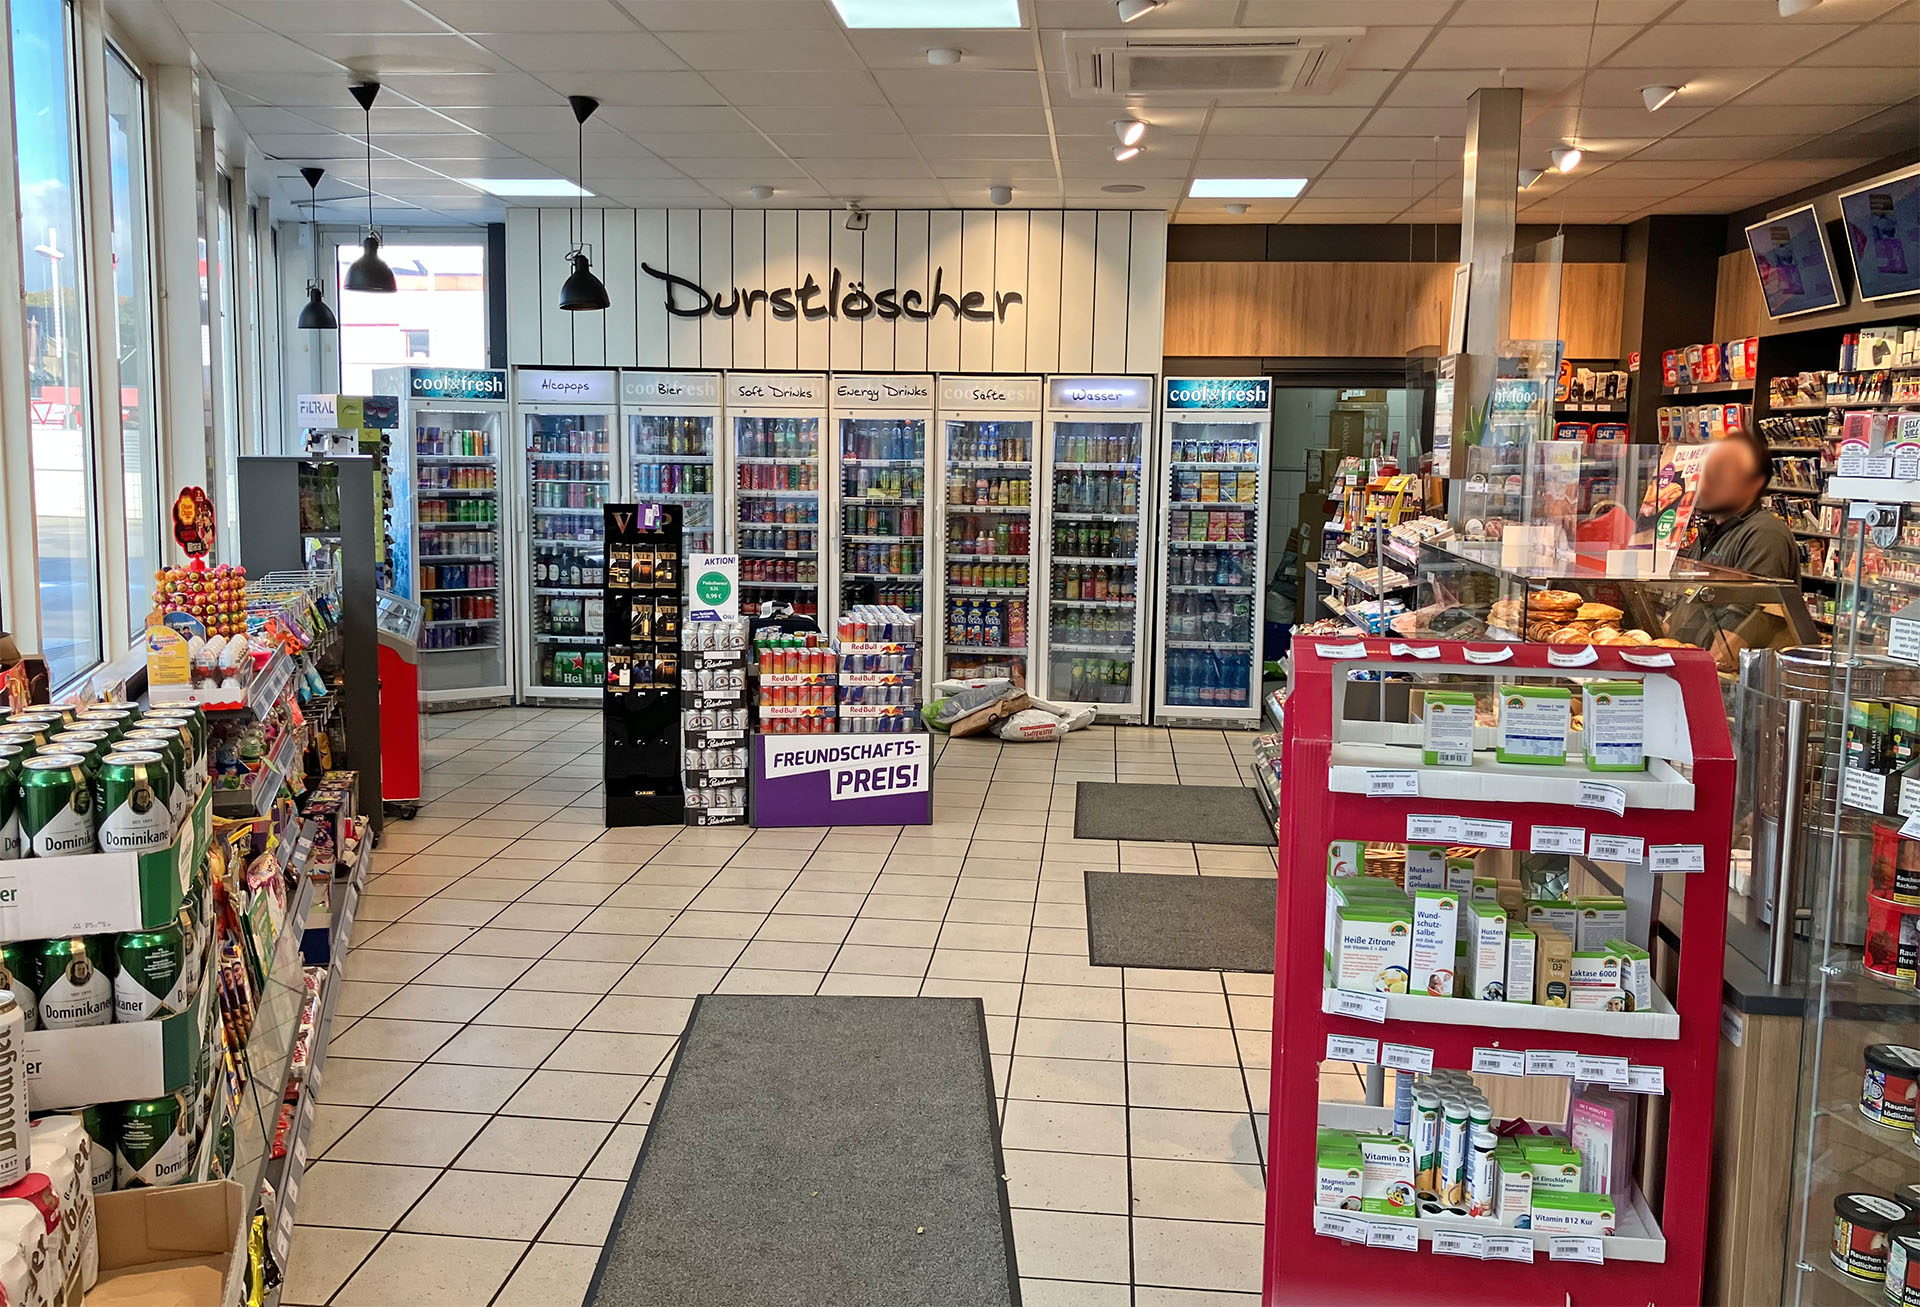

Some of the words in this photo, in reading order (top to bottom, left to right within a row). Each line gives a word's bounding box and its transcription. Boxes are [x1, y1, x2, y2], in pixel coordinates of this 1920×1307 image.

[641, 261, 1023, 323] Durstlöscher
[413, 375, 503, 393] cool&fresh
[541, 378, 590, 393] Alcopops
[657, 383, 683, 395] Bier
[738, 386, 764, 398] Soft
[768, 385, 813, 399] Drinks
[837, 385, 880, 401] Energy
[882, 384, 928, 397] Drinks
[1072, 389, 1123, 402] Wasser
[1170, 385, 1266, 402] cool&fresh
[704, 556, 736, 566] AKTION!
[773, 741, 922, 769] FREUNDSCHAFTS-
[836, 764, 919, 795] PREIS!
[1409, 866, 1435, 875] Muskel-
[1417, 911, 1441, 920] Wund-
[1417, 920, 1442, 930] schutz-
[1416, 929, 1436, 937] salbe
[1481, 928, 1504, 936] Husten
[1344, 935, 1367, 945] Heiße
[1368, 936, 1396, 947] Zitrone
[1552, 963, 1564, 971] D3
[1898, 957, 1914, 966] Ihre
[1599, 970, 1618, 978] 6000
[1364, 1152, 1397, 1163] Vitamin
[1399, 1155, 1411, 1164] D3
[1321, 1177, 1357, 1187] Magnesium
[1541, 1175, 1574, 1184] Einschlafen
[1535, 1214, 1563, 1224] Vitamin
[1565, 1216, 1579, 1225] B12
[1580, 1218, 1594, 1226] Kur
[1850, 1250, 1882, 1264] Rauchen
[1849, 1258, 1881, 1271] tödlichen
